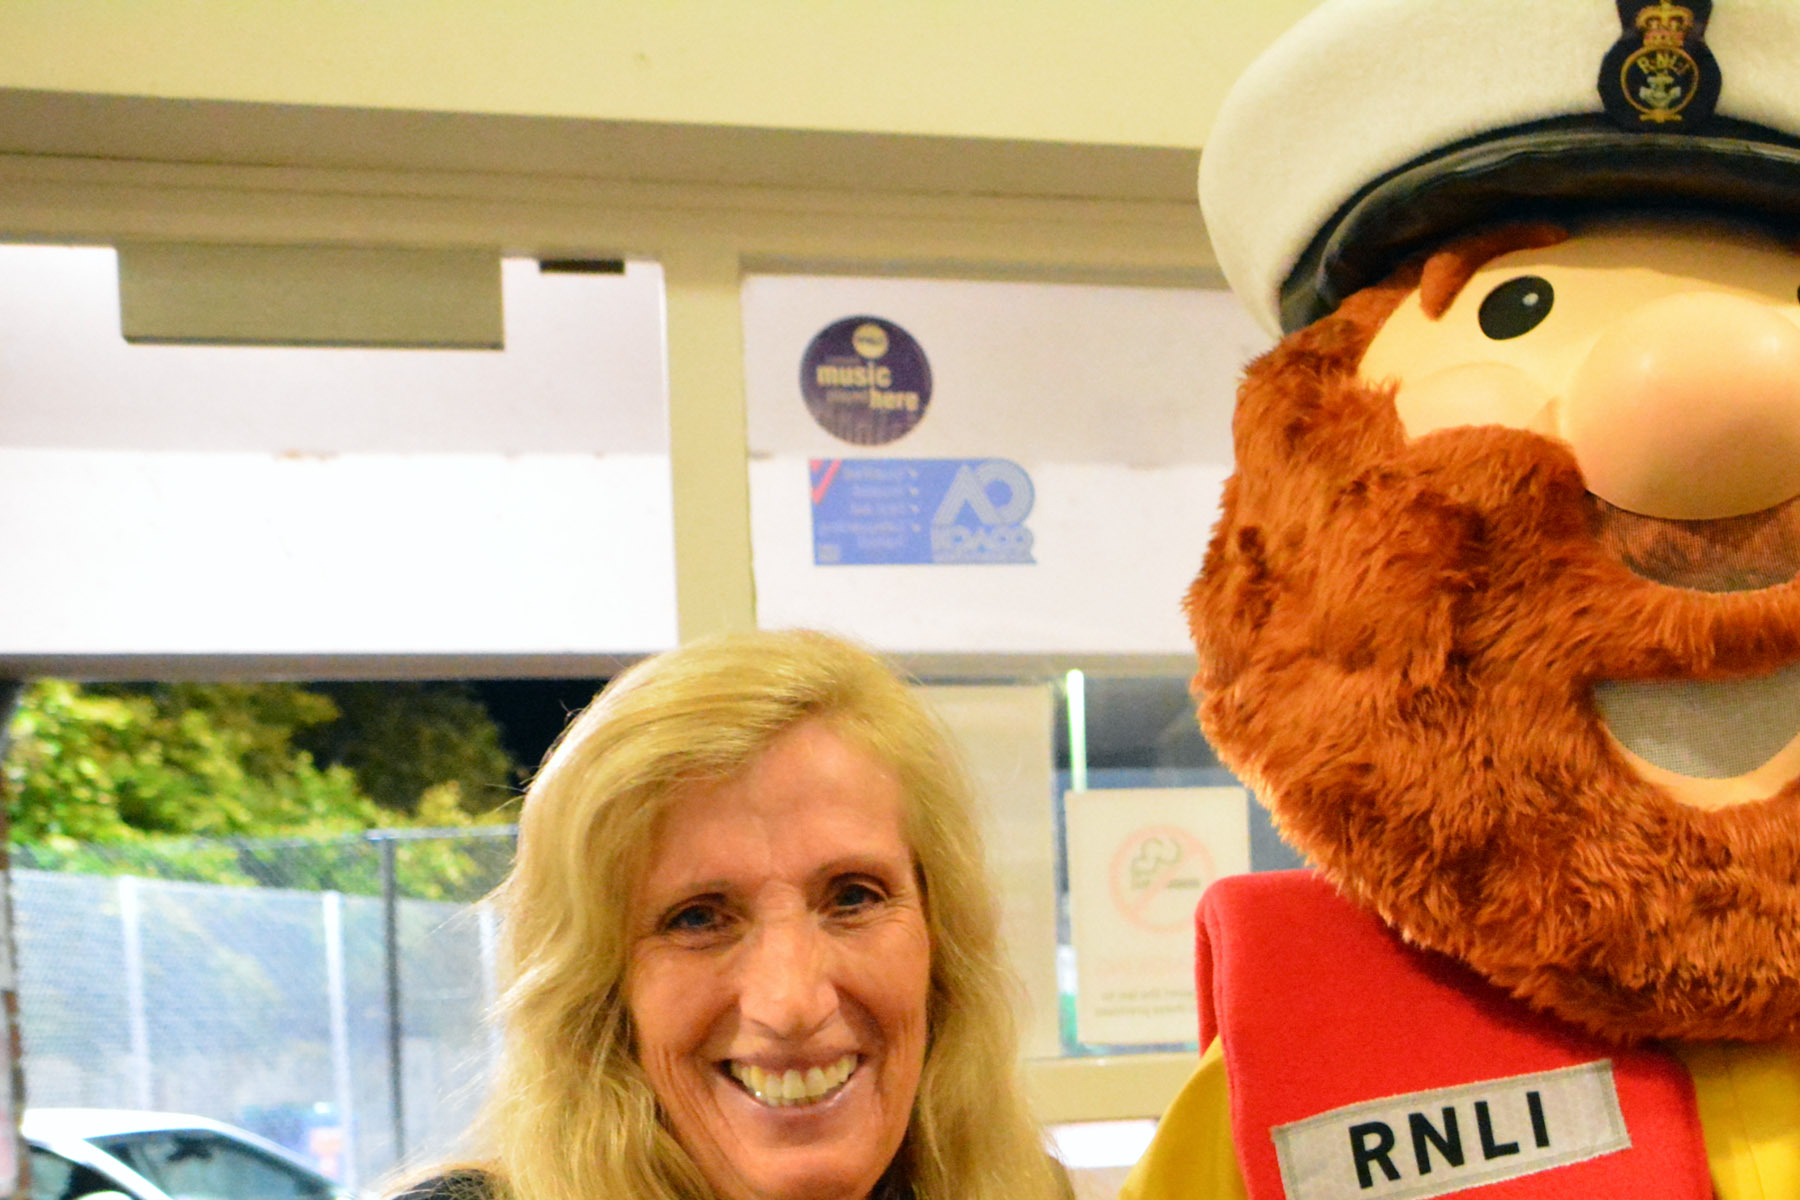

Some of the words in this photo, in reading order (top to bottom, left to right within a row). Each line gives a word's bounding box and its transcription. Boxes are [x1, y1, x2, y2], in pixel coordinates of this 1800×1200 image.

[816, 362, 893, 388] music
[870, 388, 920, 412] here
[1348, 1090, 1551, 1189] RNLI
